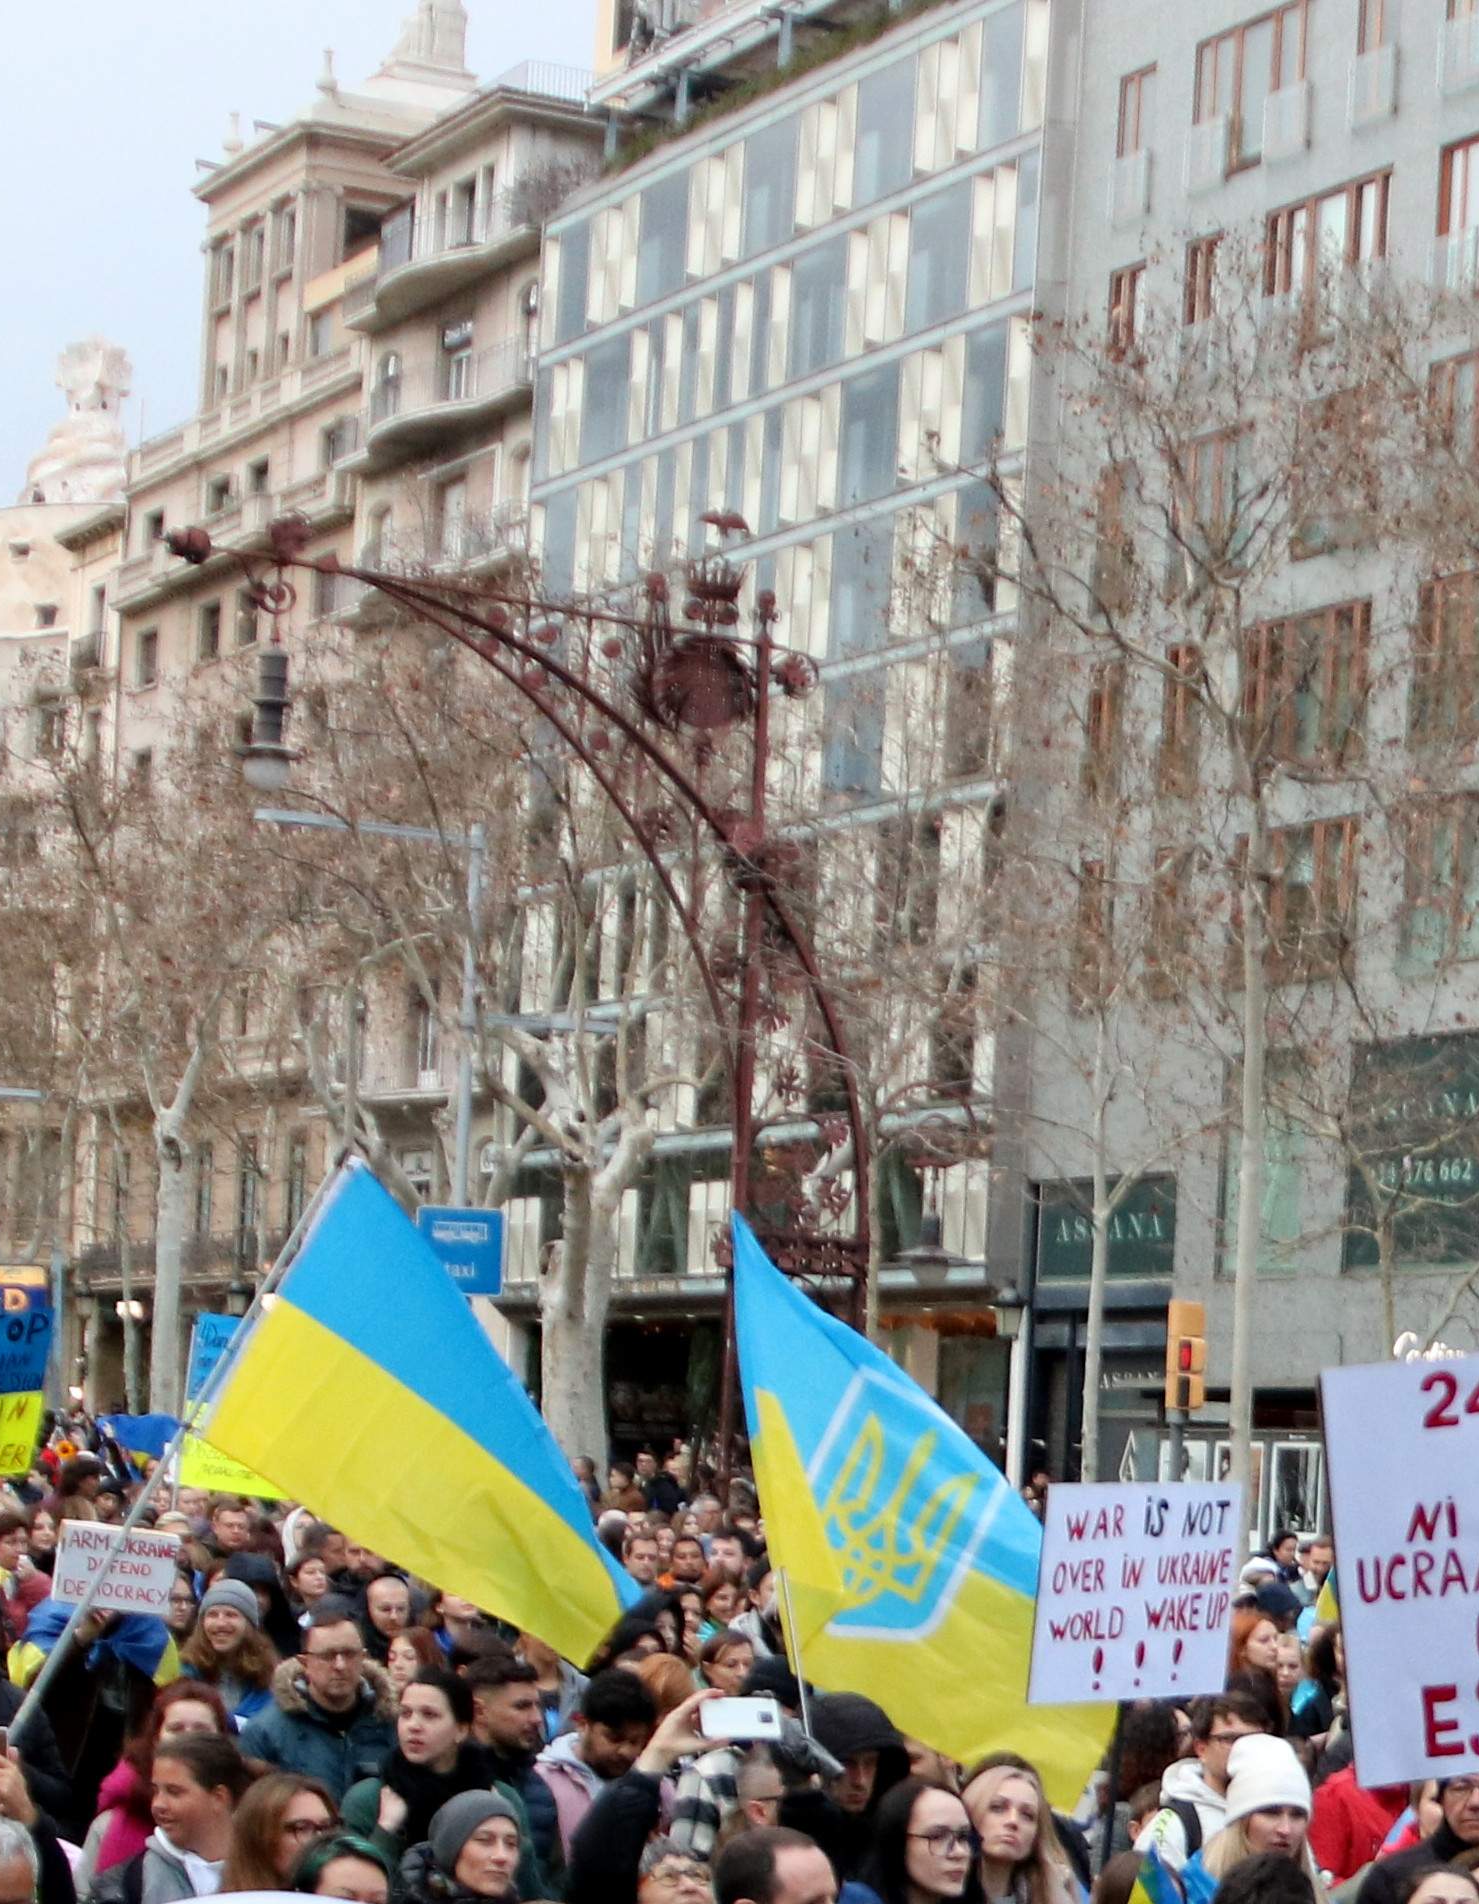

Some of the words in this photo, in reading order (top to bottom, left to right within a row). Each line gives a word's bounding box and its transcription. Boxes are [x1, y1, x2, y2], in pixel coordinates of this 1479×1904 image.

[1056, 1212, 1163, 1243] ASANA
[1066, 1504, 1124, 1542] WAR
[1181, 1500, 1231, 1538] NOT
[70, 1530, 110, 1551] ARM
[87, 1556, 151, 1576] DFEND
[1052, 1557, 1105, 1594] OVER
[1048, 1606, 1124, 1641] WORLD
[1145, 1593, 1202, 1632] WAKE
[1206, 1591, 1230, 1630] UP
